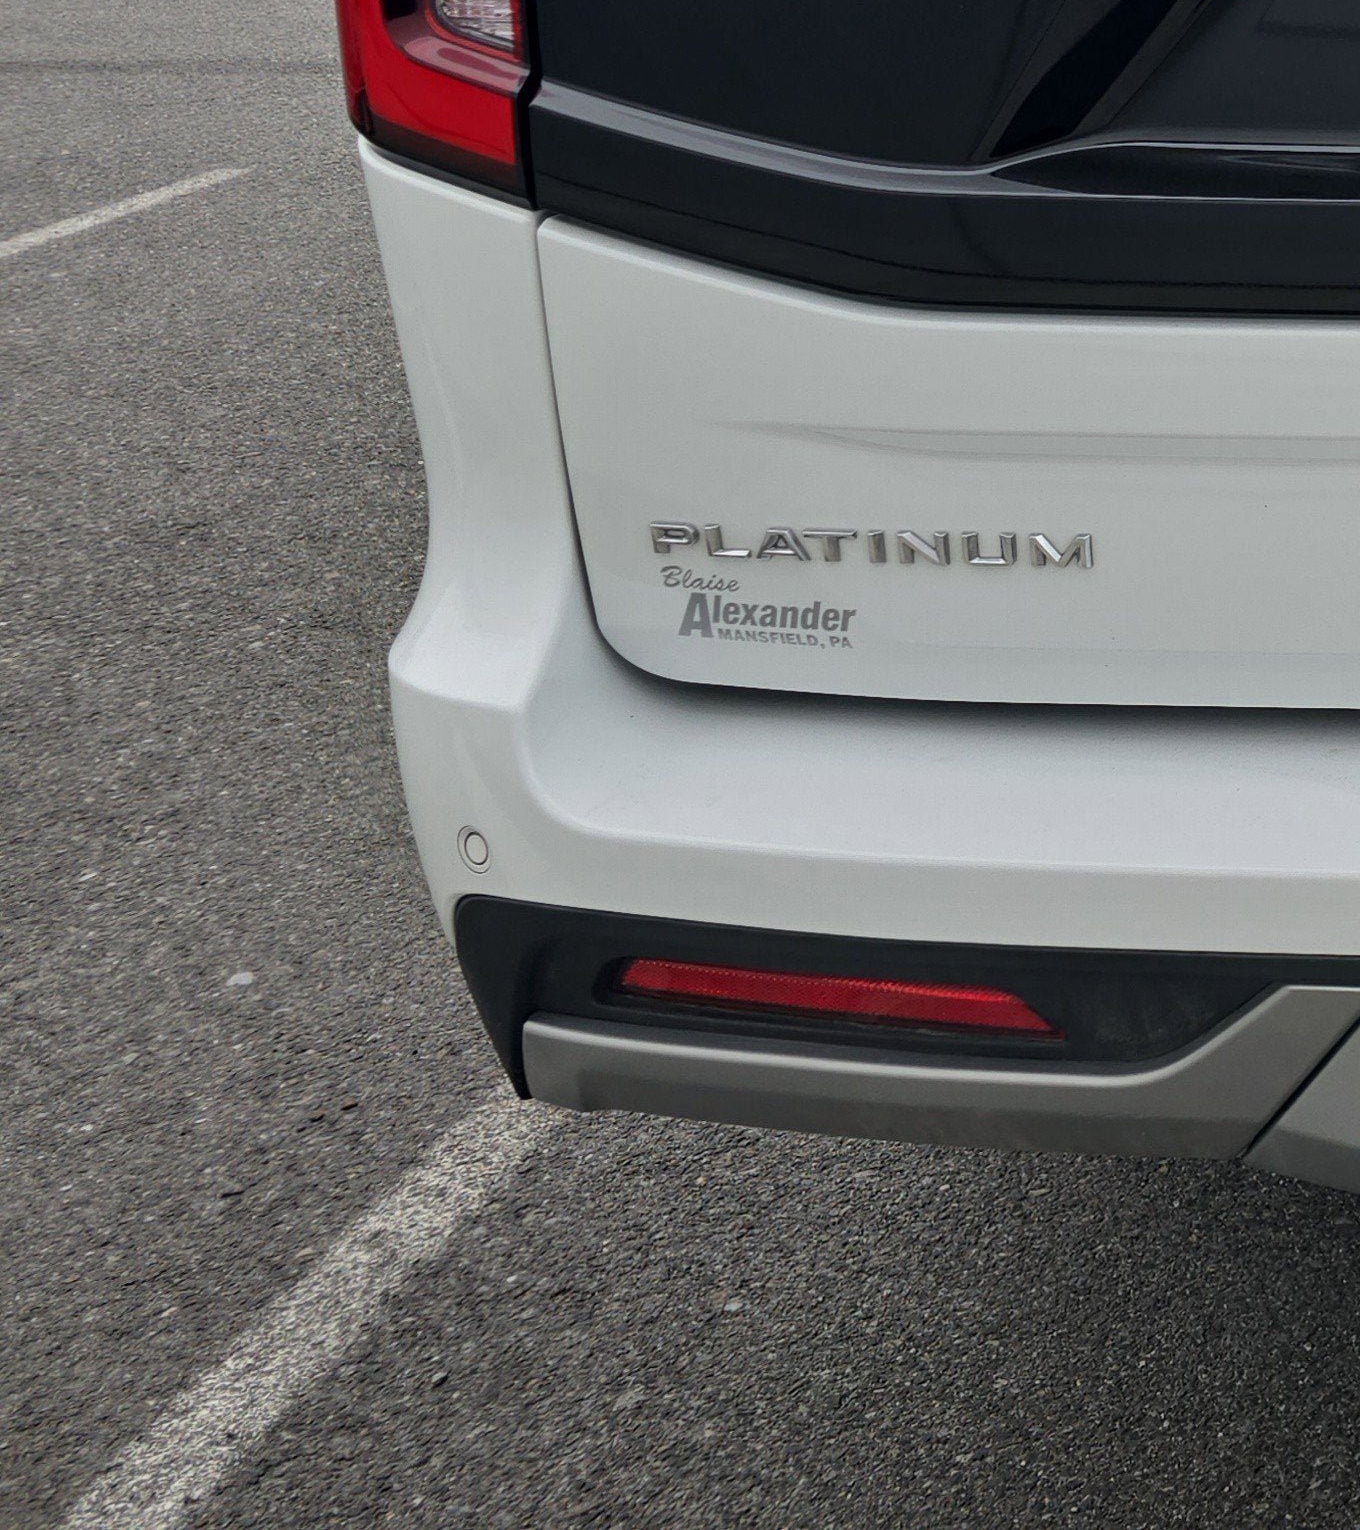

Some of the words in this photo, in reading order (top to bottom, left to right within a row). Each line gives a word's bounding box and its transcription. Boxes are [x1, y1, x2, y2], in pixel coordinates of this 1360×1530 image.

[649, 520, 1094, 568] PLATINUM
[660, 565, 740, 592] Blaise
[678, 592, 857, 638] Alexander
[716, 628, 826, 650] MANSFIELD,
[829, 636, 854, 649] PA
